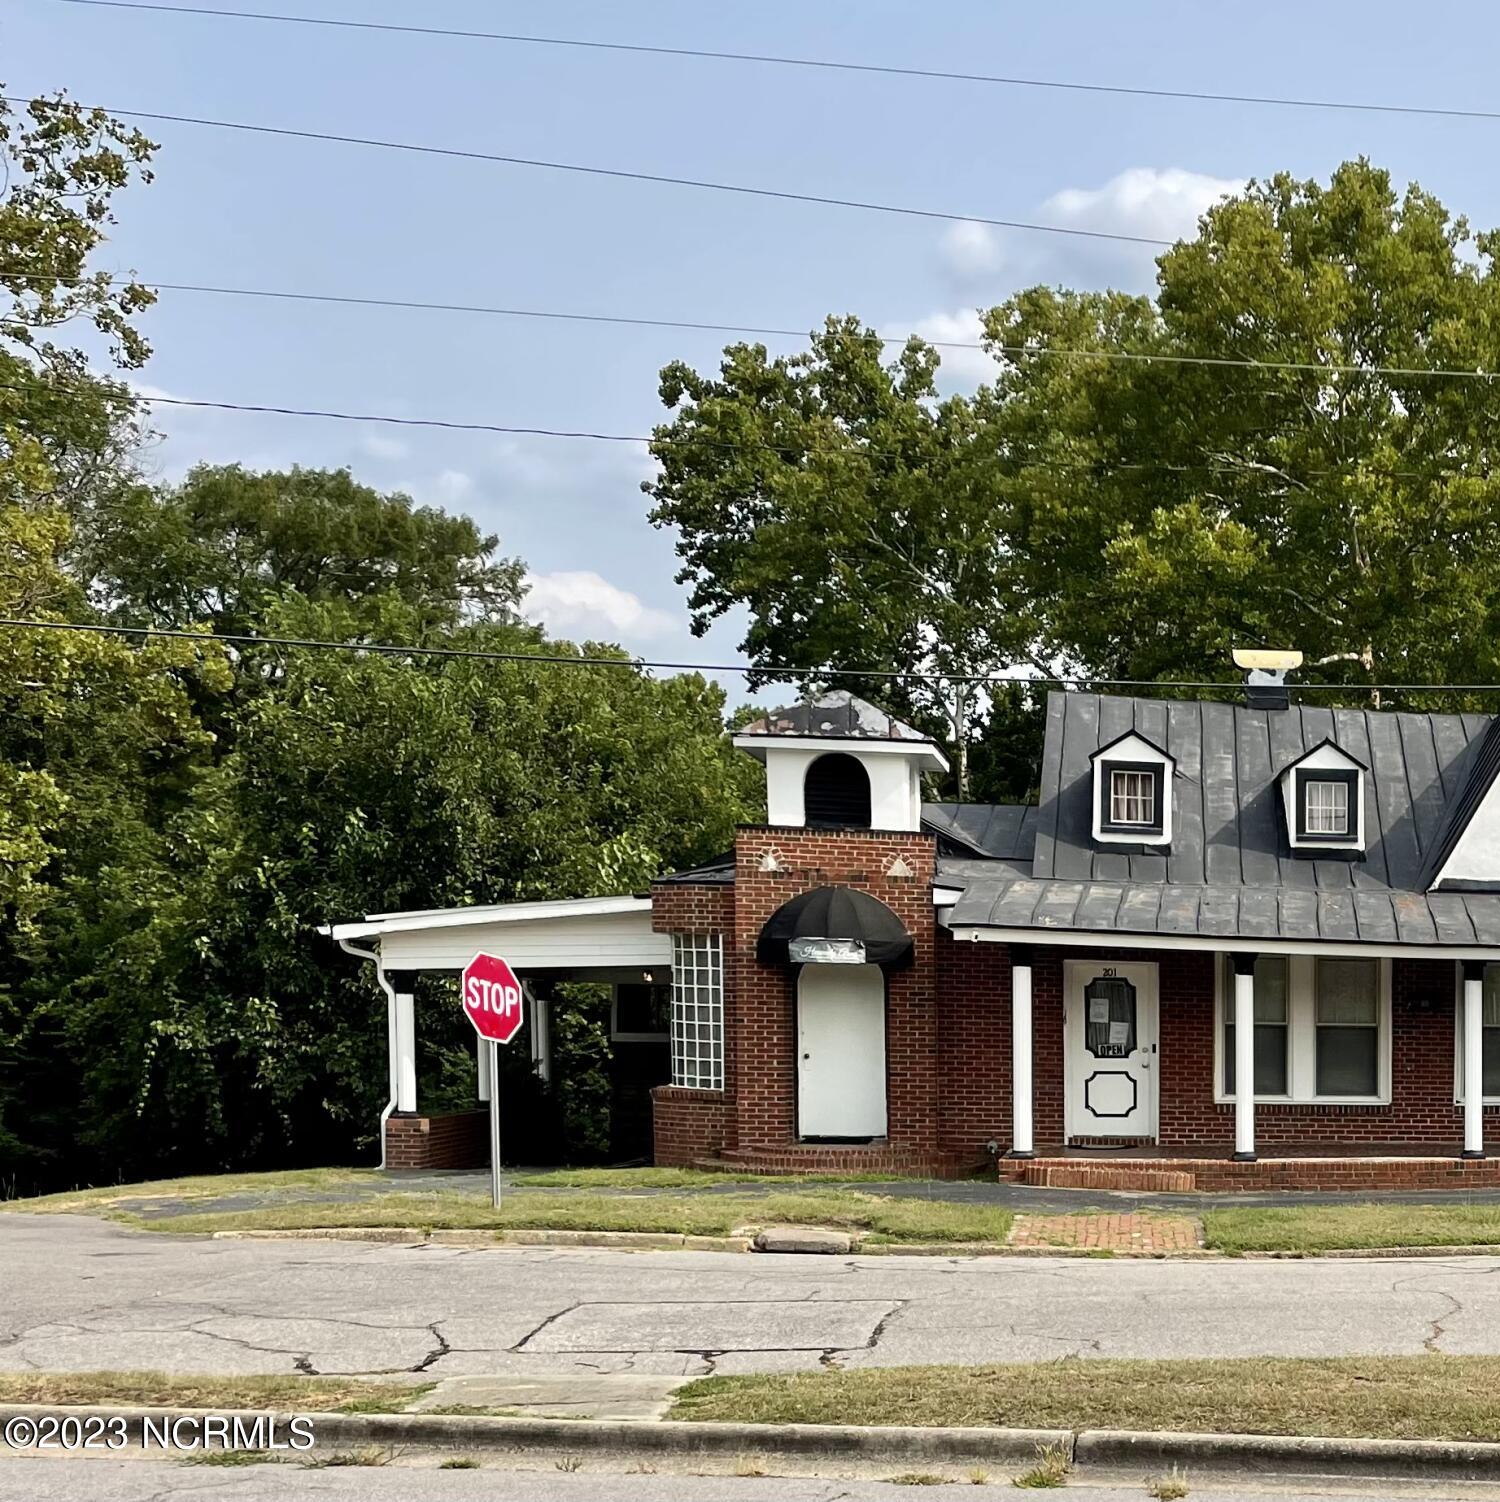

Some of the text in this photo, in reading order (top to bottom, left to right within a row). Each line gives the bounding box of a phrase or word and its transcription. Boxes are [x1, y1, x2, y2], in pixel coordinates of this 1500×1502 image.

[1103, 967, 1117, 977] 201
[467, 976, 519, 1017] STOP
[1100, 1044, 1123, 1055] OPEN
